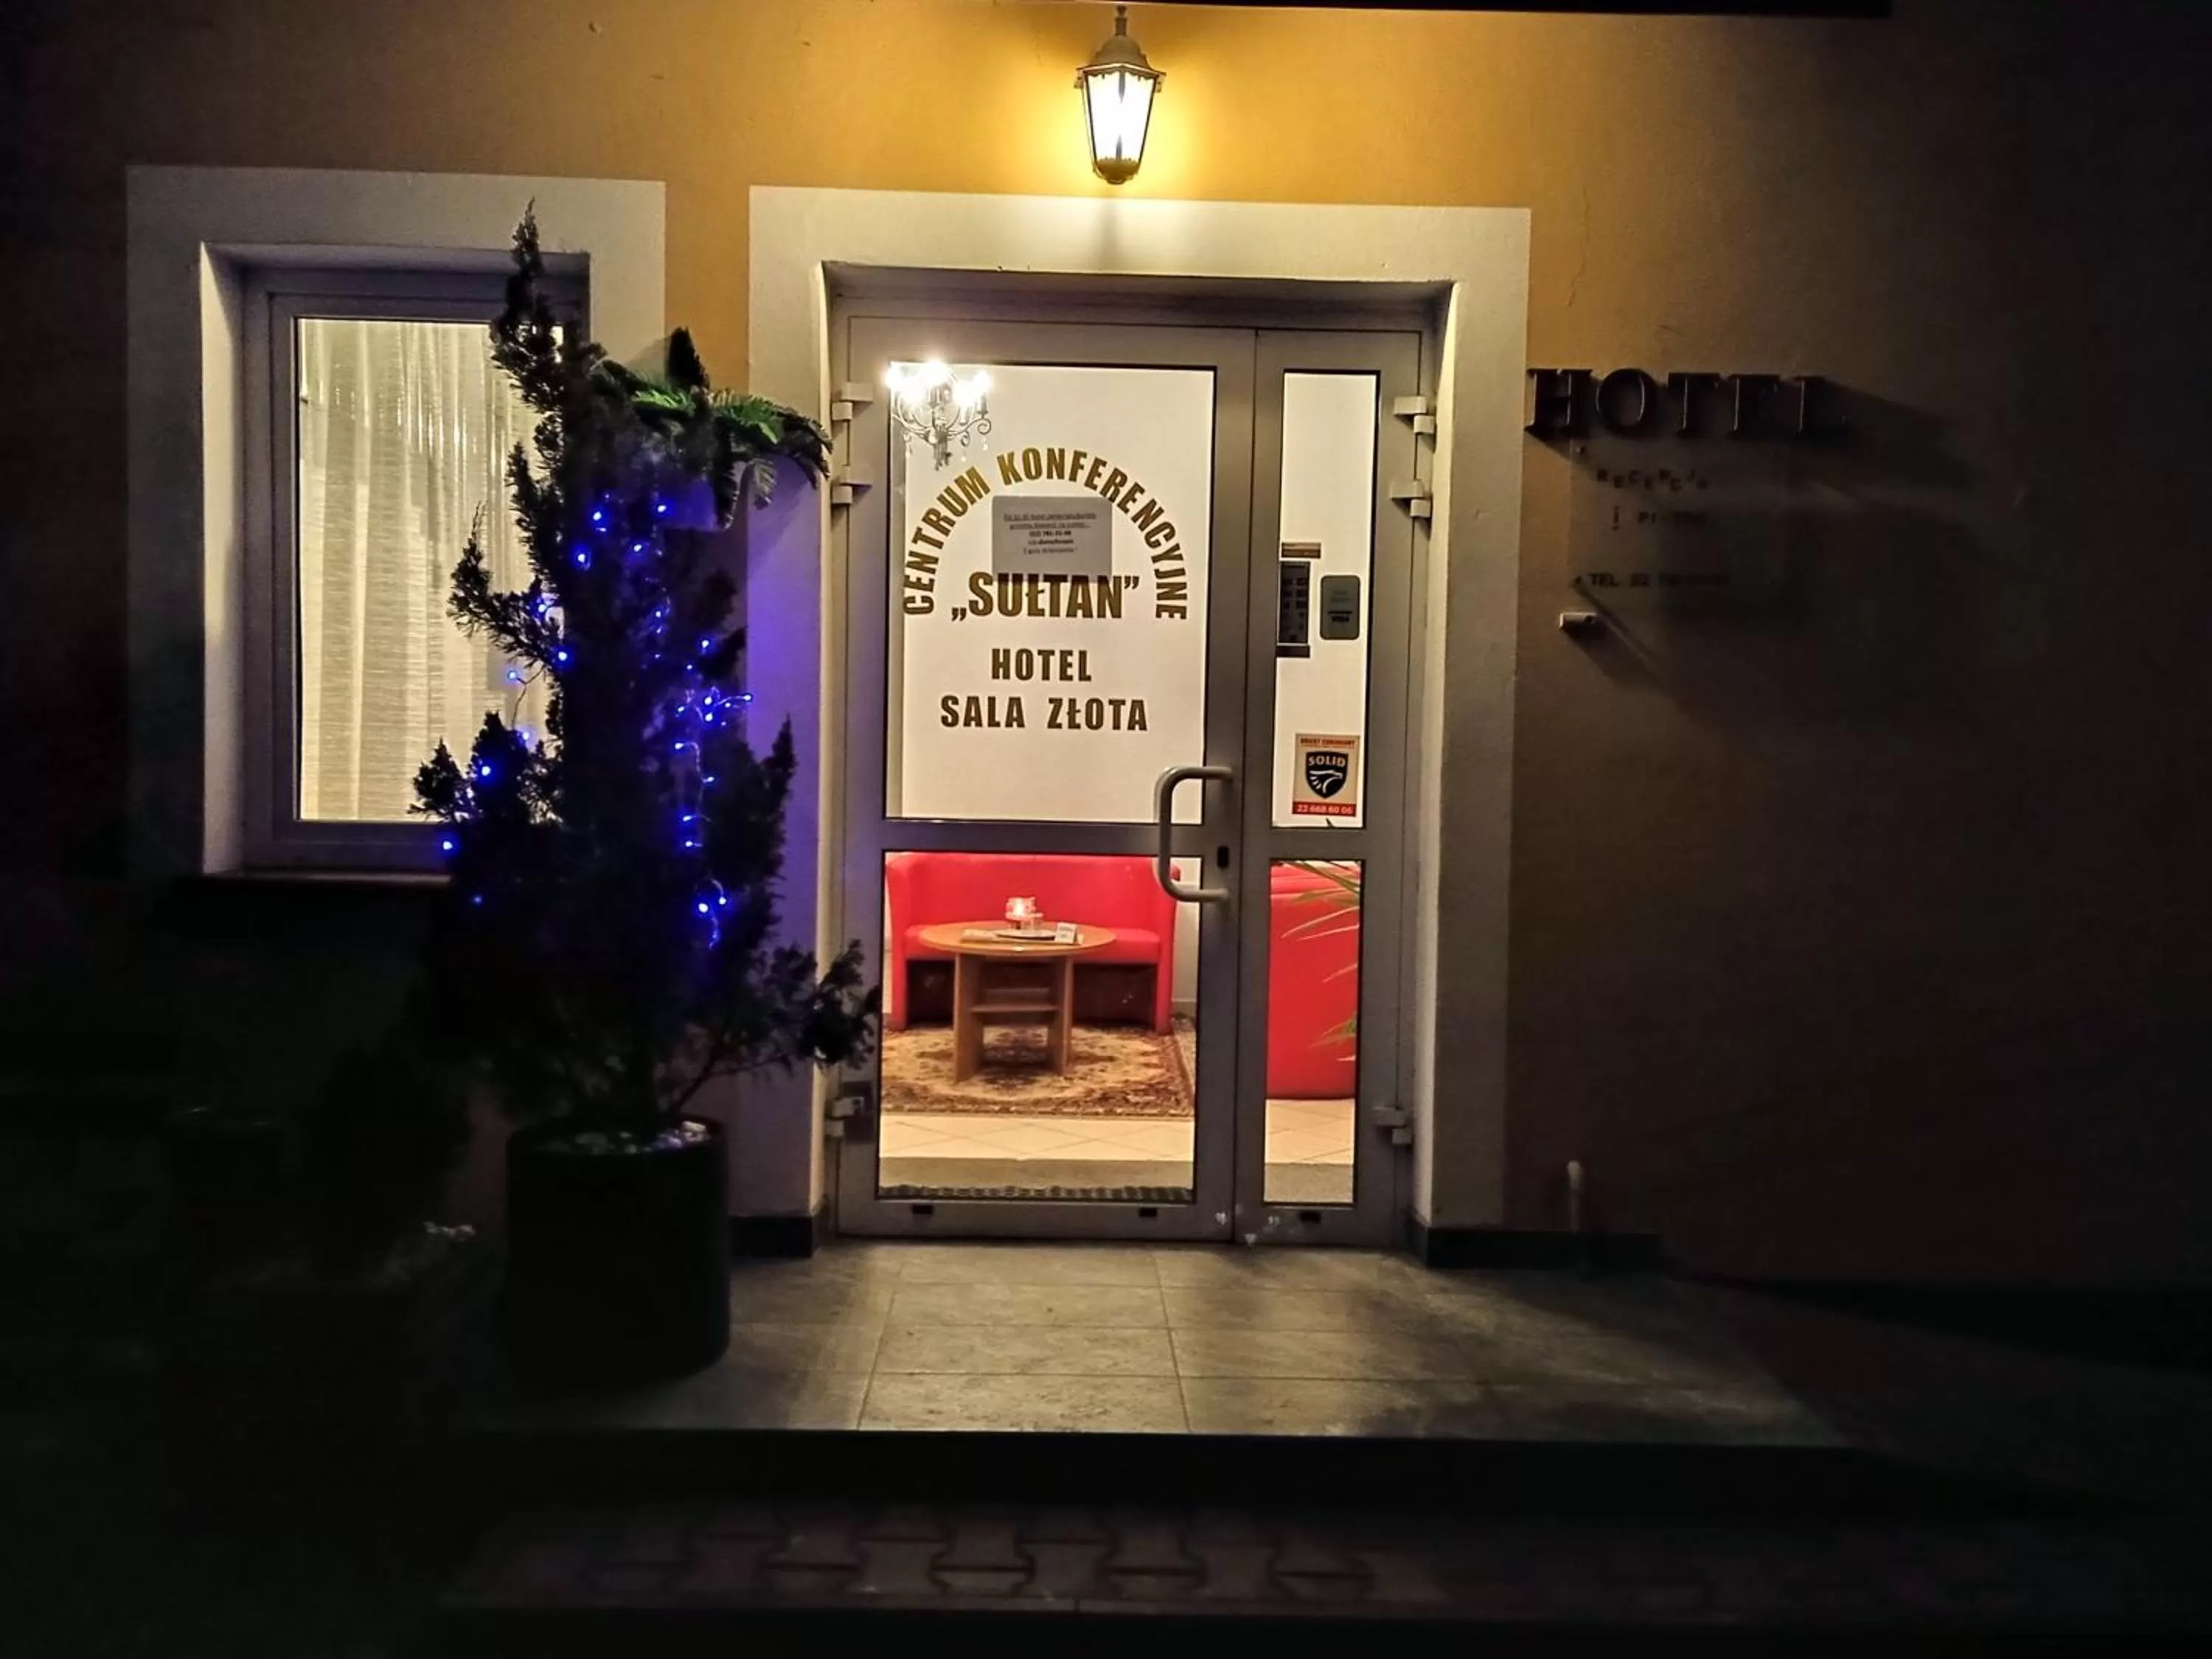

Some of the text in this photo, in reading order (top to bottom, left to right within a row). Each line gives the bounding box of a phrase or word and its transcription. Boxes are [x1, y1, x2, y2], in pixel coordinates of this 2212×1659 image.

[1525, 368, 1848, 439] HOTEL
[903, 448, 1188, 620] CENTRUM KONFERENCYJNE
[951, 571, 1140, 622] „SUŁTAN”
[991, 648, 1092, 682] HOTEL
[940, 695, 1148, 731] SALA ZŁOTA
[1308, 755, 1346, 768] SOLID
